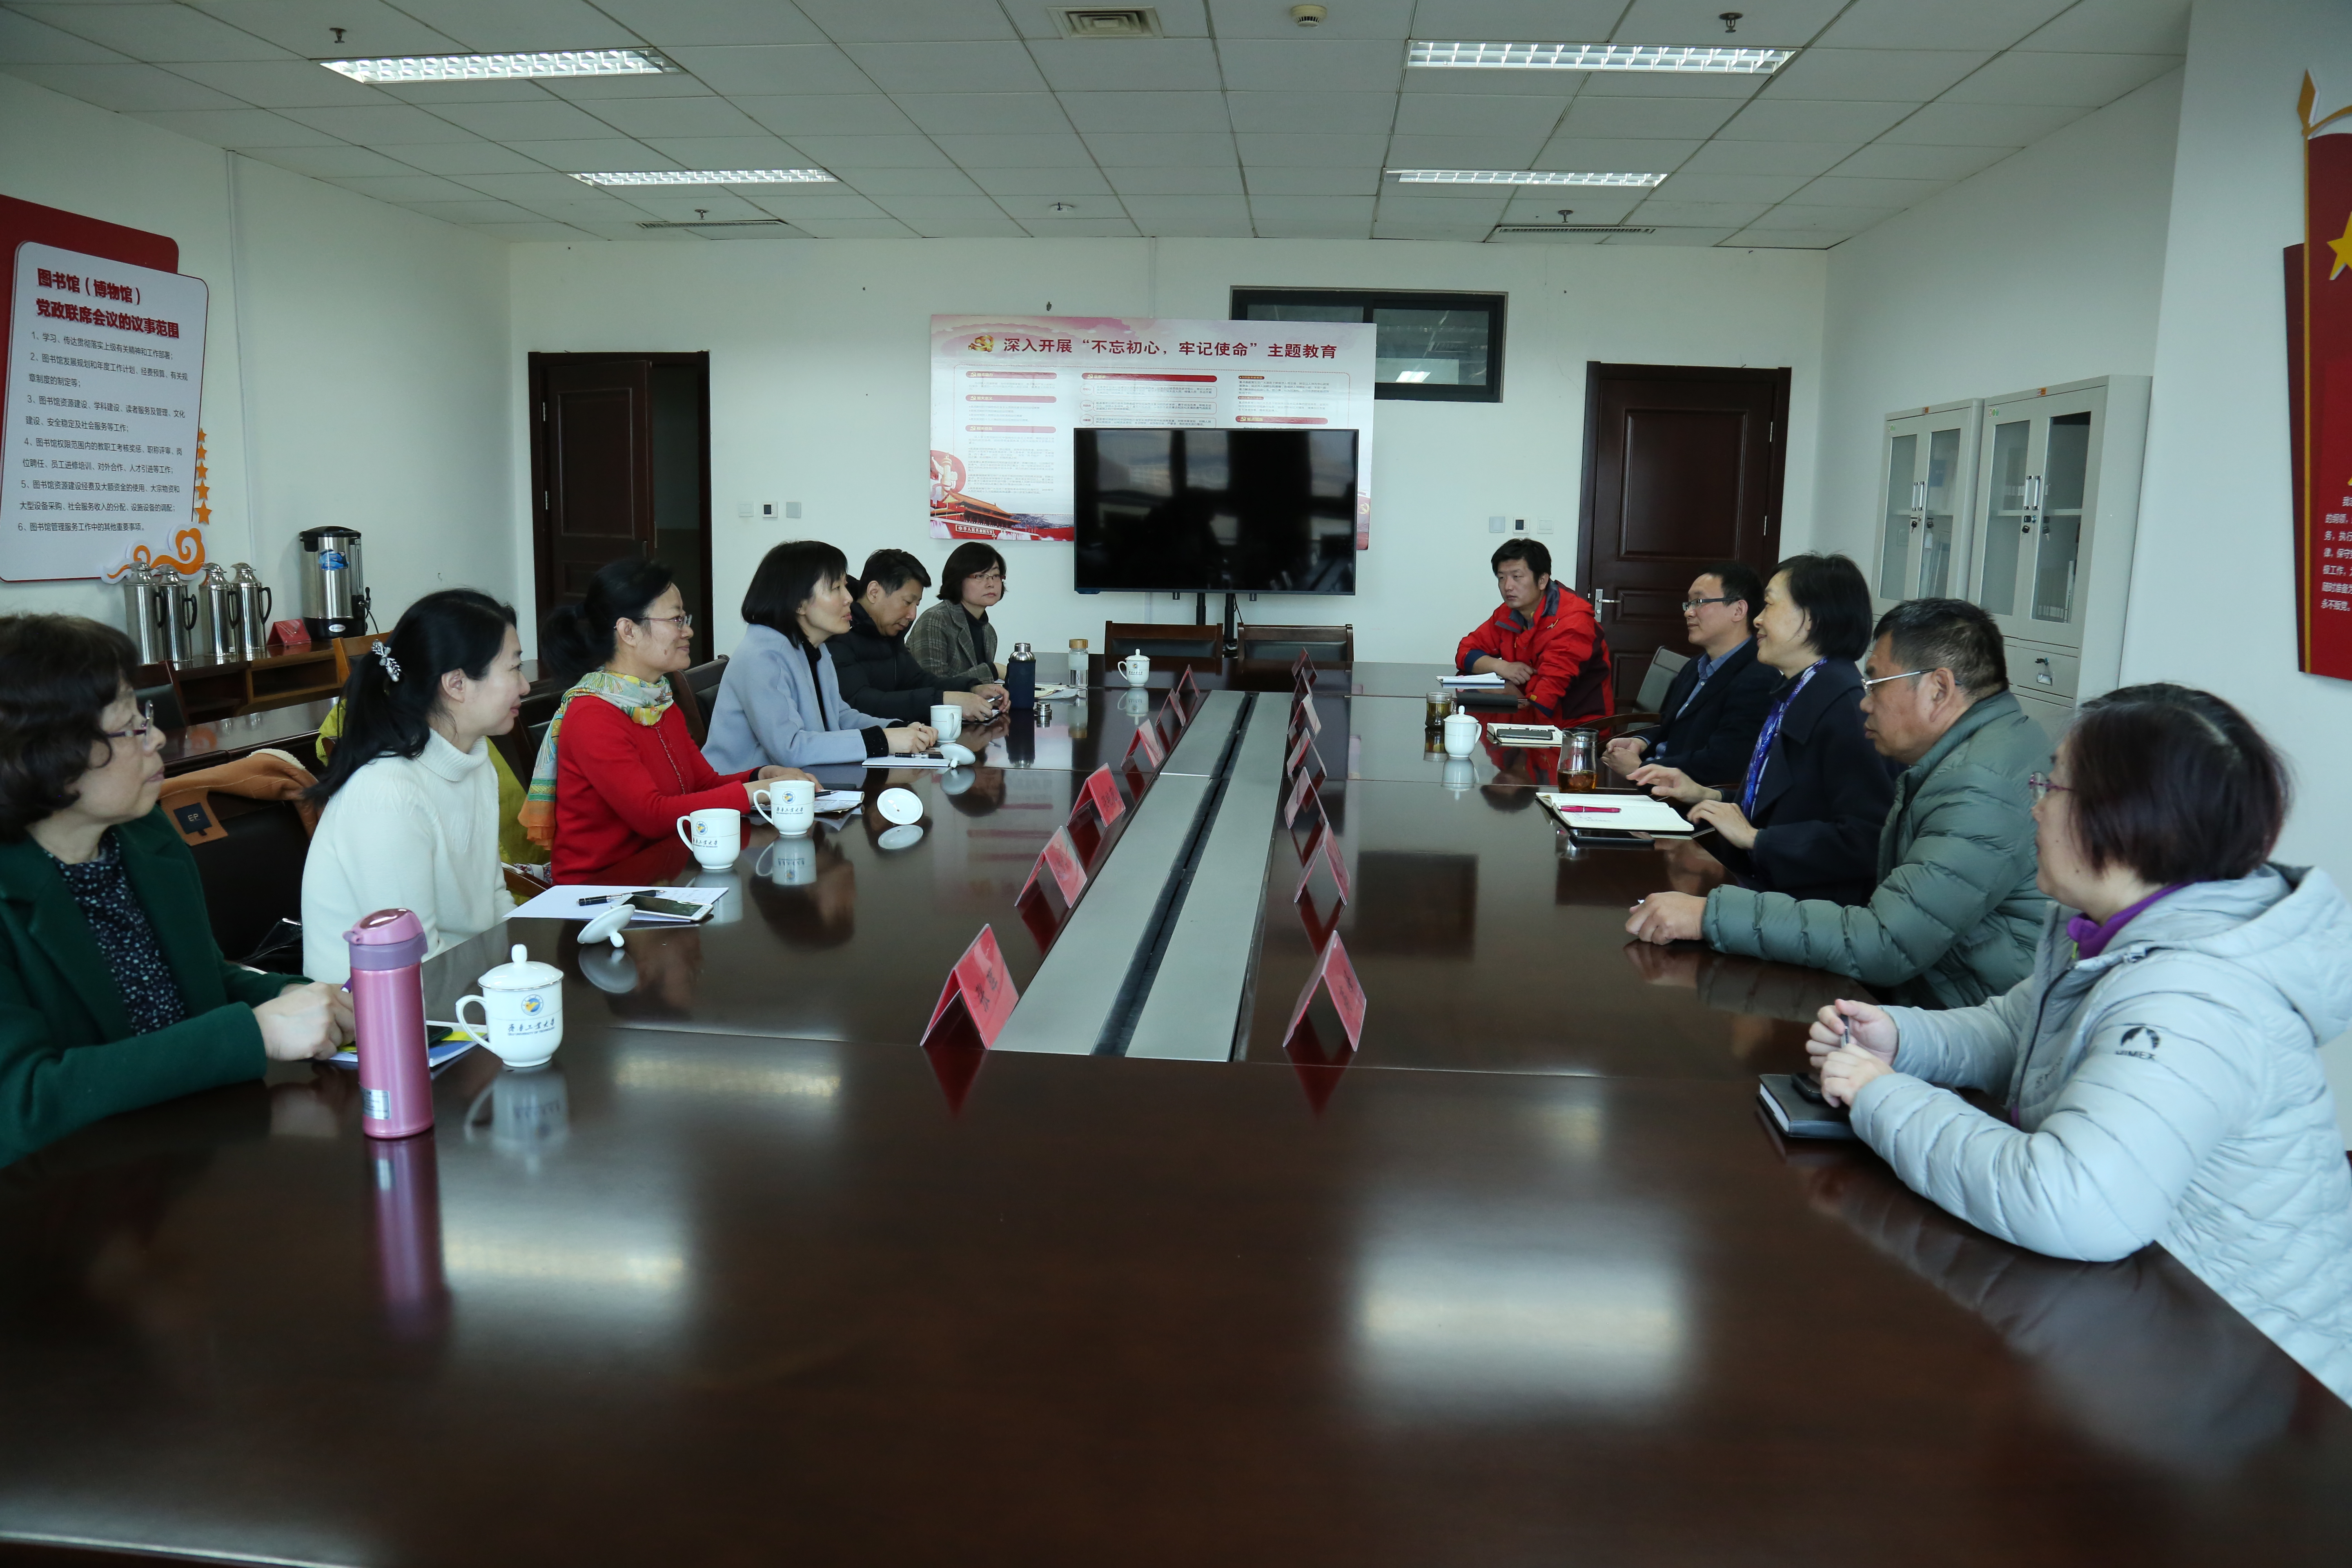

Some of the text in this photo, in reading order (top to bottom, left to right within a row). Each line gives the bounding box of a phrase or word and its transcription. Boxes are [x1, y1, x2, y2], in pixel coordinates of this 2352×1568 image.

[37, 268, 141, 305] 图书馆（博物馆）
[36, 298, 180, 339] 党政联席会议的议事范围
[30, 352, 188, 382] 2、图书馆发展规划和年度工作计划、经费预算、有关规
[27, 394, 186, 419] 3、图书馆资源建设、学科建设、读者服务及管理、文化
[24, 438, 183, 456] 4、图书馆权限范围内的教职工考核奖惩、职称评审、岗
[21, 480, 180, 493] 5、图书馆资源建设经费及大额资金的使用、大宗物资和
[18, 522, 145, 532] 6、图书馆管理服务工作中的其他重要事项。
[188, 813, 199, 822] EP
